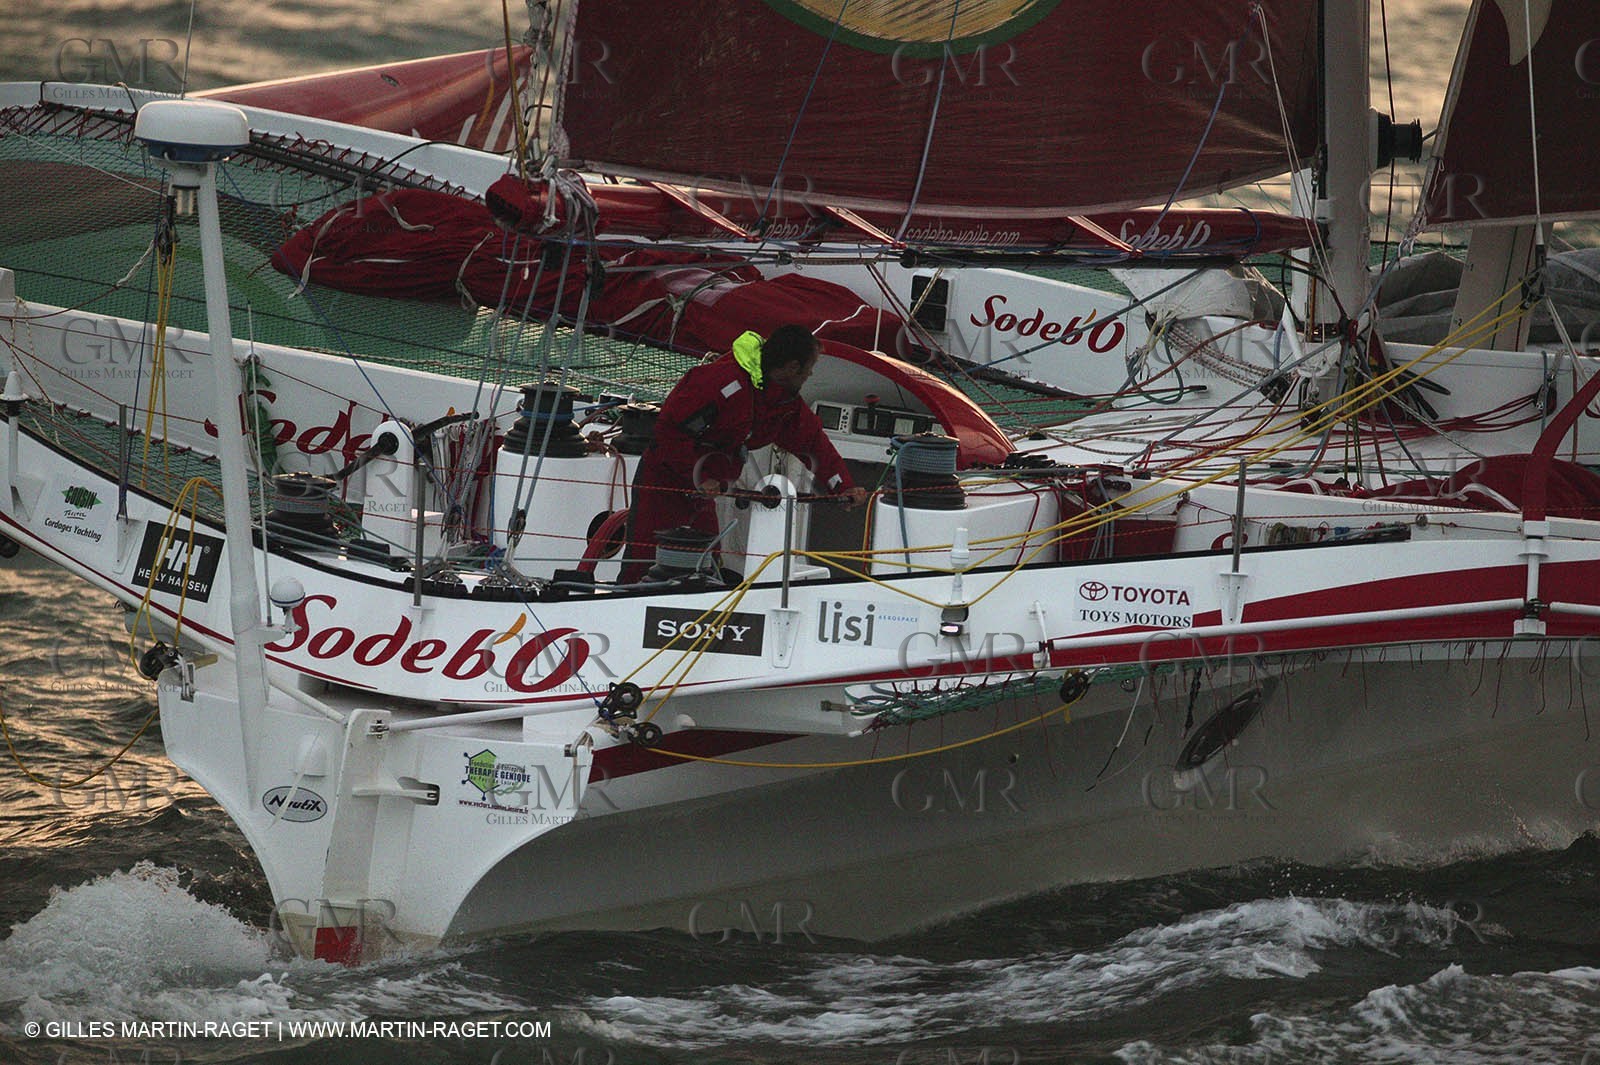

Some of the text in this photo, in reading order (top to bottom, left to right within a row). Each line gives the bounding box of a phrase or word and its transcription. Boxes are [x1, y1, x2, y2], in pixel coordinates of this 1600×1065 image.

[970, 295, 1125, 353] Sodeb'O
[1111, 585, 1190, 606] TOYOTA
[1079, 609, 1191, 628] TOYS MOTORS
[657, 619, 751, 642] SONY
